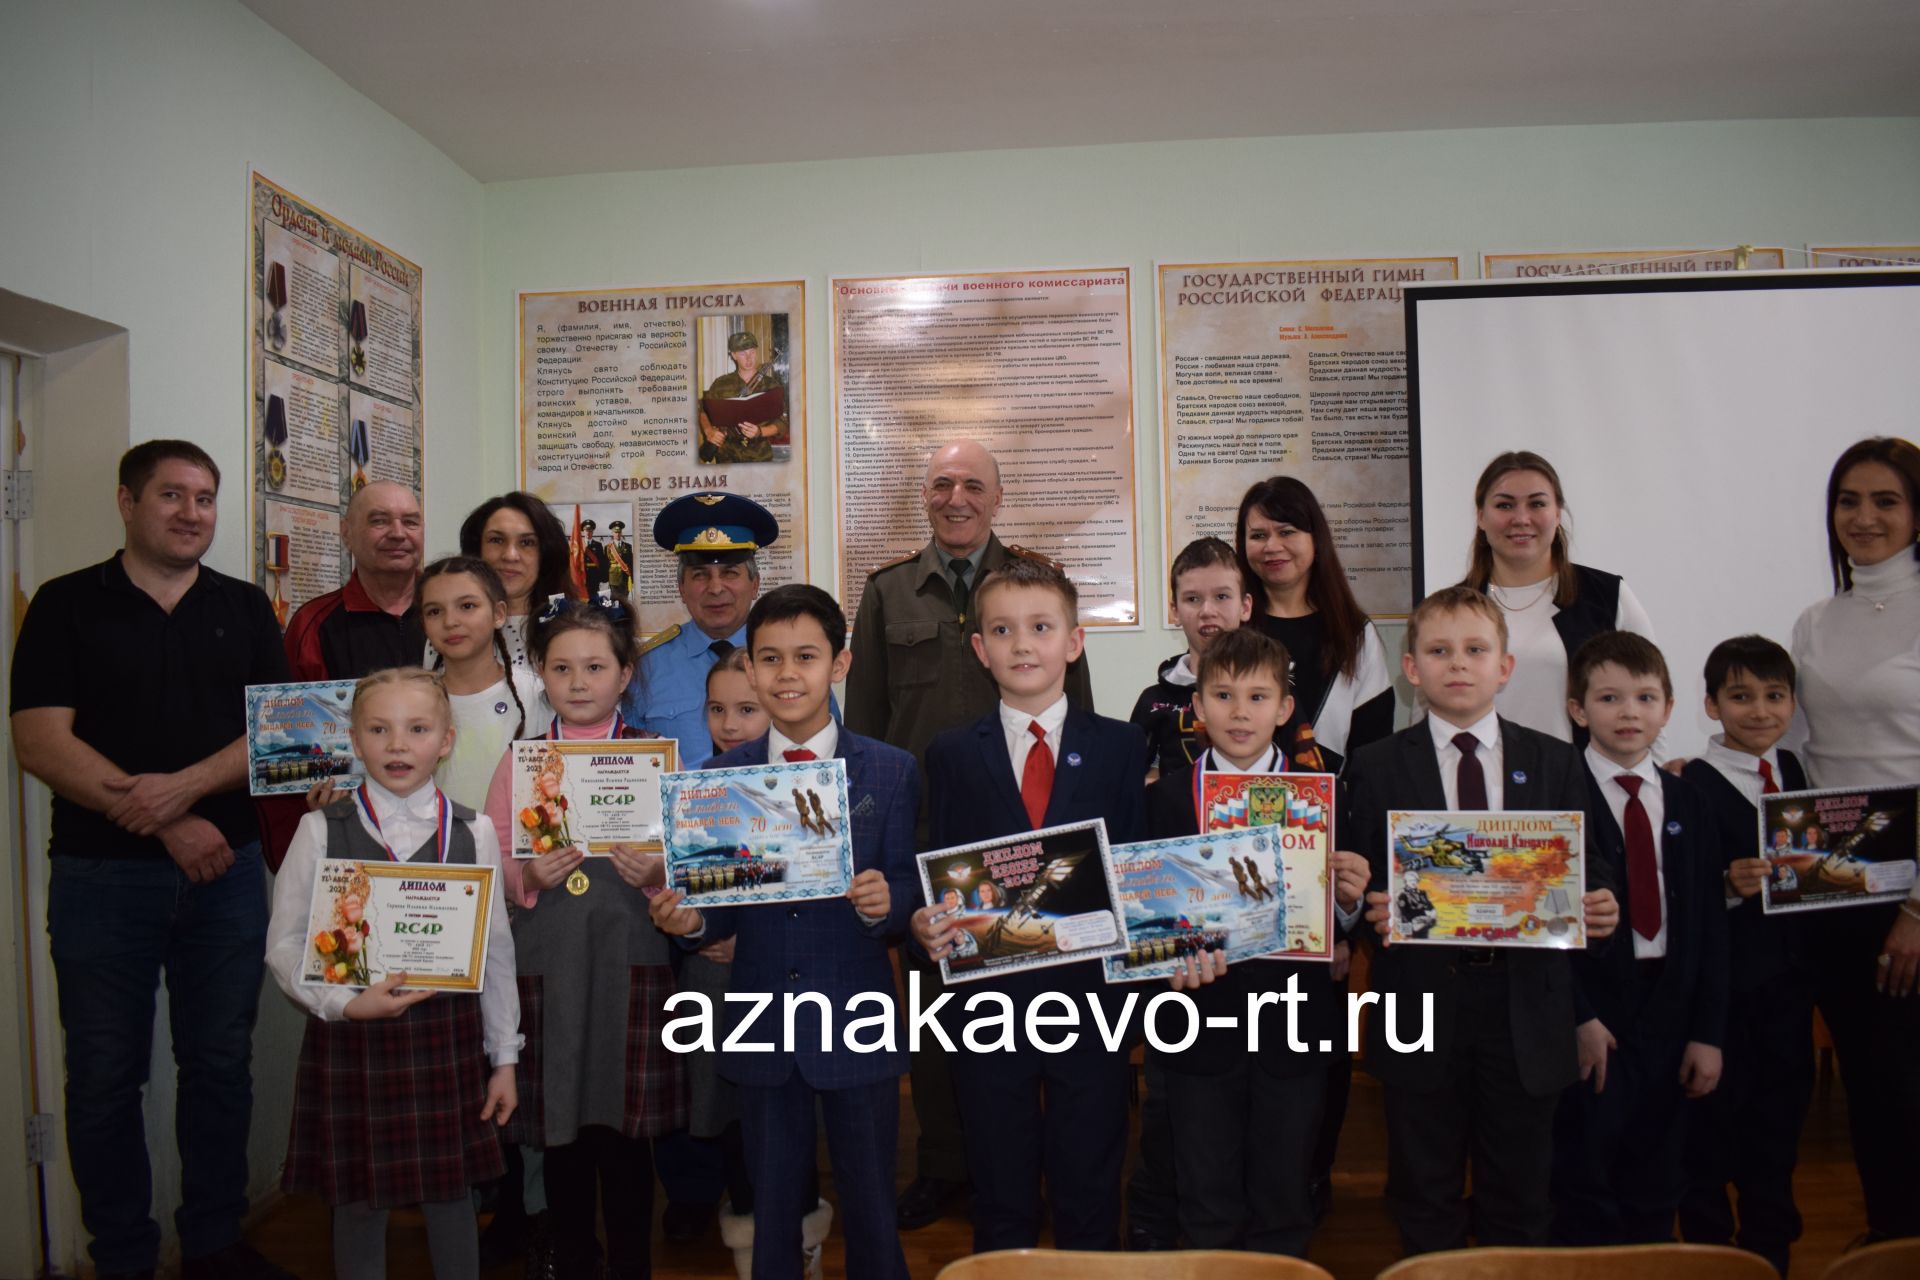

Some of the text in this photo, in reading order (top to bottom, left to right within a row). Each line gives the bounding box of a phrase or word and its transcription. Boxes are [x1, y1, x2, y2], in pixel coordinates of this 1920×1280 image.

[1705, 260, 1735, 272] ГЕР
[963, 280, 1024, 290] военного
[1029, 276, 1124, 288] комиссариата
[1183, 268, 1425, 289] ГОСУДАРСТВЕННЫЙ ГИМН
[1178, 287, 1401, 305] РОССИЙСКОЙ ФЕДЕРАЦ
[577, 294, 745, 313] ВОЕННАЯ ПРИСЯГА
[537, 324, 546, 334] Я,
[537, 335, 592, 345] торжественно
[596, 333, 633, 343] присягаю
[650, 331, 687, 340] верность
[537, 339, 687, 355] своему Отечеству Российской
[537, 355, 583, 365] Федерации.
[537, 367, 573, 376] Клянусь
[640, 362, 687, 371] соблюдать
[537, 373, 687, 387] Конституцию Российской Федерации,
[537, 383, 687, 398] строго выполнять требования
[595, 398, 632, 407] уставов,
[651, 395, 687, 405] приказы
[537, 410, 585, 419] командиров
[593, 408, 646, 416] начальников.
[537, 417, 688, 430] Клянусь достойно исполнять
[537, 428, 688, 439] воинский долг, мужественно
[538, 443, 578, 452] защищать
[582, 440, 616, 450] свободу,
[619, 439, 679, 448] независимость
[538, 449, 688, 462] конституционный строй России,
[537, 465, 562, 474] народ
[570, 463, 614, 471] Отечество.
[599, 475, 728, 491] БОЕВОЕ ЗНАМЯ
[590, 756, 634, 767] ДИПЛОМ
[590, 794, 635, 806] RC4P
[680, 787, 727, 801] ДИПЛОМ
[749, 816, 767, 832] 70
[1476, 820, 1552, 832] ДИПЛОМ
[1466, 833, 1509, 848] Николай
[399, 880, 446, 892] ДИПЛОМ
[1186, 888, 1205, 903] 70
[394, 921, 443, 935] RC4P
